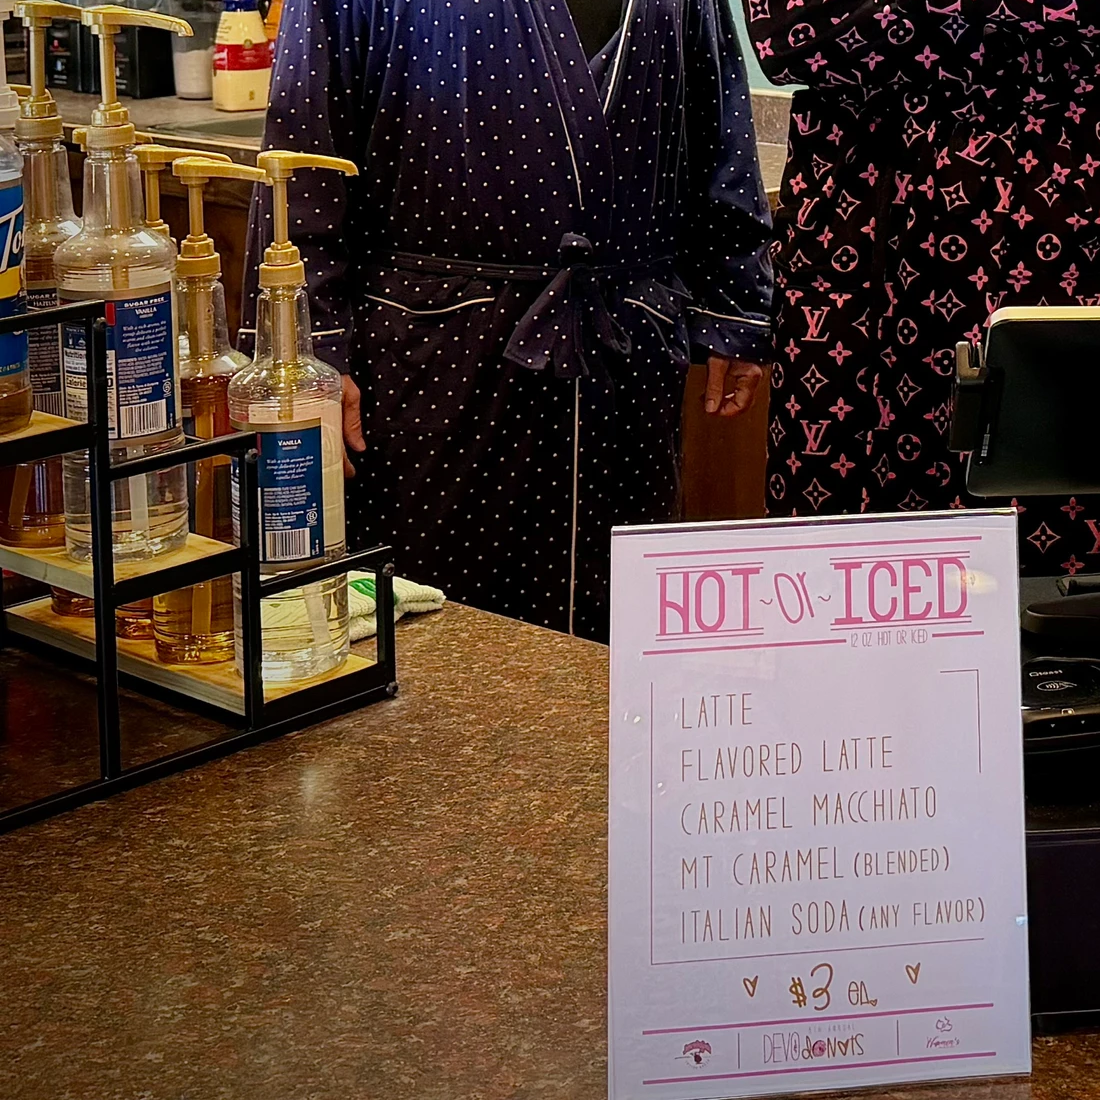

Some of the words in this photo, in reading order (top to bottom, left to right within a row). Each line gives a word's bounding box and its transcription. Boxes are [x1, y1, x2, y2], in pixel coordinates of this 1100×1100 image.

[278, 439, 302, 447] VANILLA
[659, 567, 762, 636] HOT
[833, 557, 969, 625] ICED
[850, 632, 859, 648] 12
[862, 631, 873, 647] OZ
[877, 630, 892, 646] HOT
[896, 629, 908, 645] OR
[681, 692, 753, 729] LATTE
[681, 742, 803, 783] FLAVORED
[822, 735, 893, 773] LATTE
[681, 796, 793, 836] CARAMEL
[813, 785, 938, 827] MACCHIATO
[681, 854, 713, 890] MT
[733, 846, 845, 886] CARAMEL
[853, 846, 951, 878] (BLENDED)
[681, 905, 772, 944] ITALIAN
[791, 899, 850, 936] SODA
[858, 901, 899, 932] (ANY
[912, 896, 986, 927] FLAVOR)
[788, 962, 834, 1011] $3
[763, 1031, 800, 1064] DEVO
